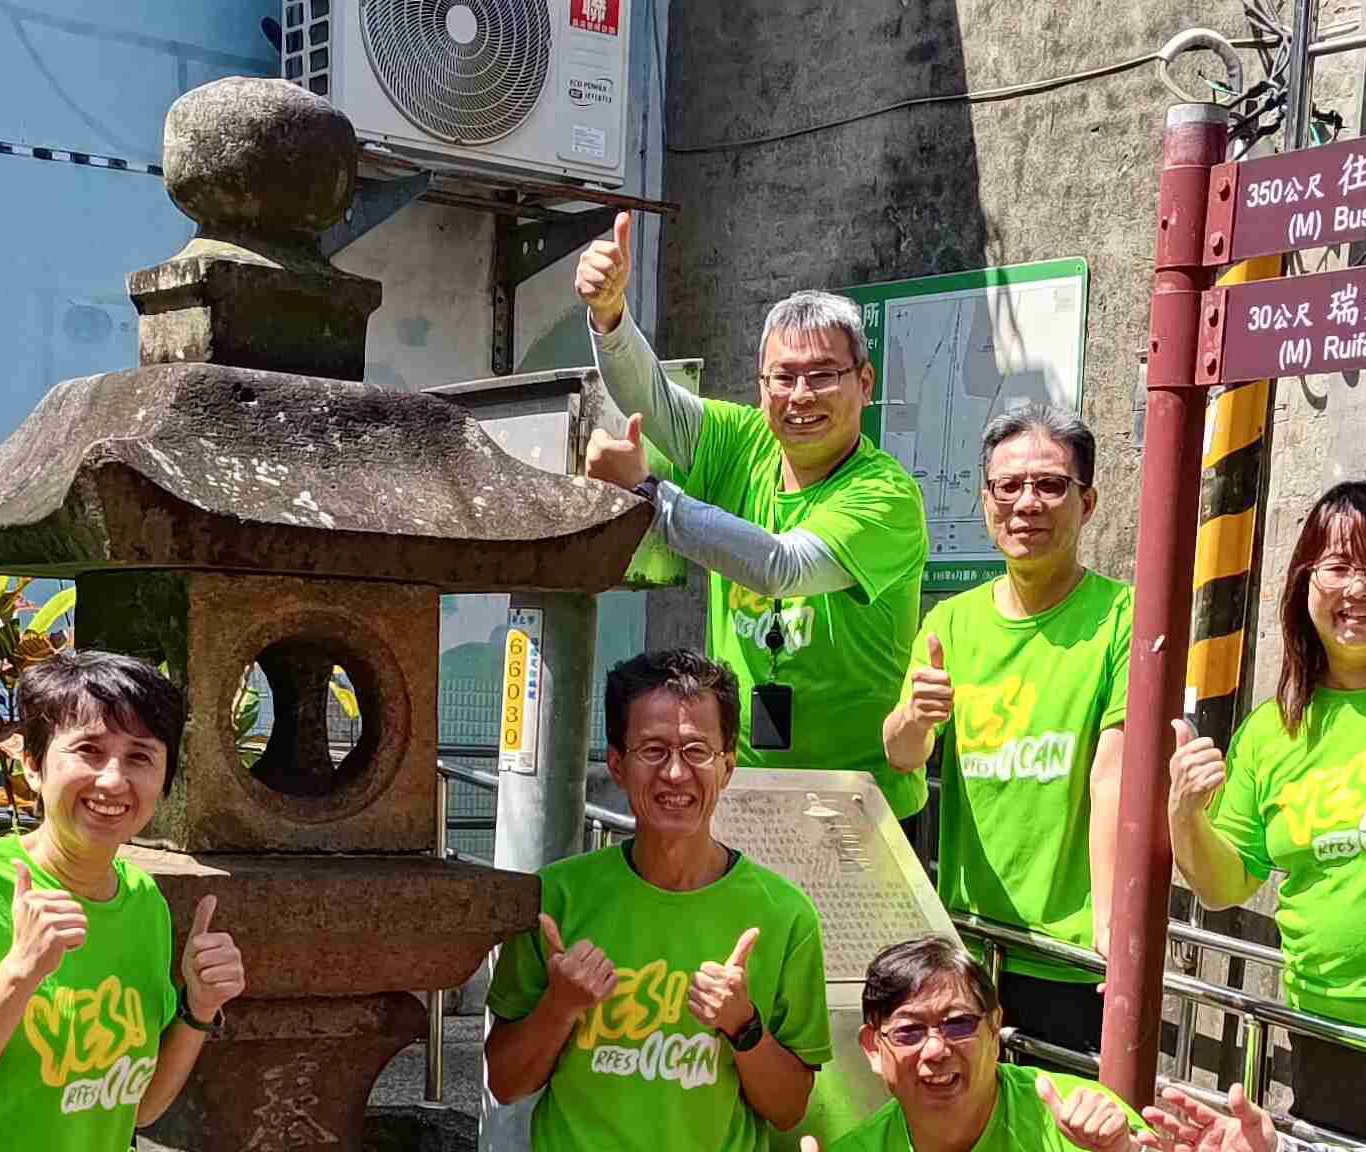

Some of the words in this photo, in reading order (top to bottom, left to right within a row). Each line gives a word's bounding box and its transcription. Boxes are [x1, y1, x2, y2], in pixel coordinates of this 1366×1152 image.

[1246, 173, 1324, 208] 350公尺
[1288, 209, 1322, 244] (M)
[1247, 302, 1313, 331] 30公尺
[1278, 338, 1312, 370] (M)
[505, 637, 523, 745] 66030
[1017, 735, 1071, 778] CAN
[25, 977, 147, 1088] YES!
[594, 1048, 636, 1073] RFES
[662, 1035, 719, 1085] CAN
